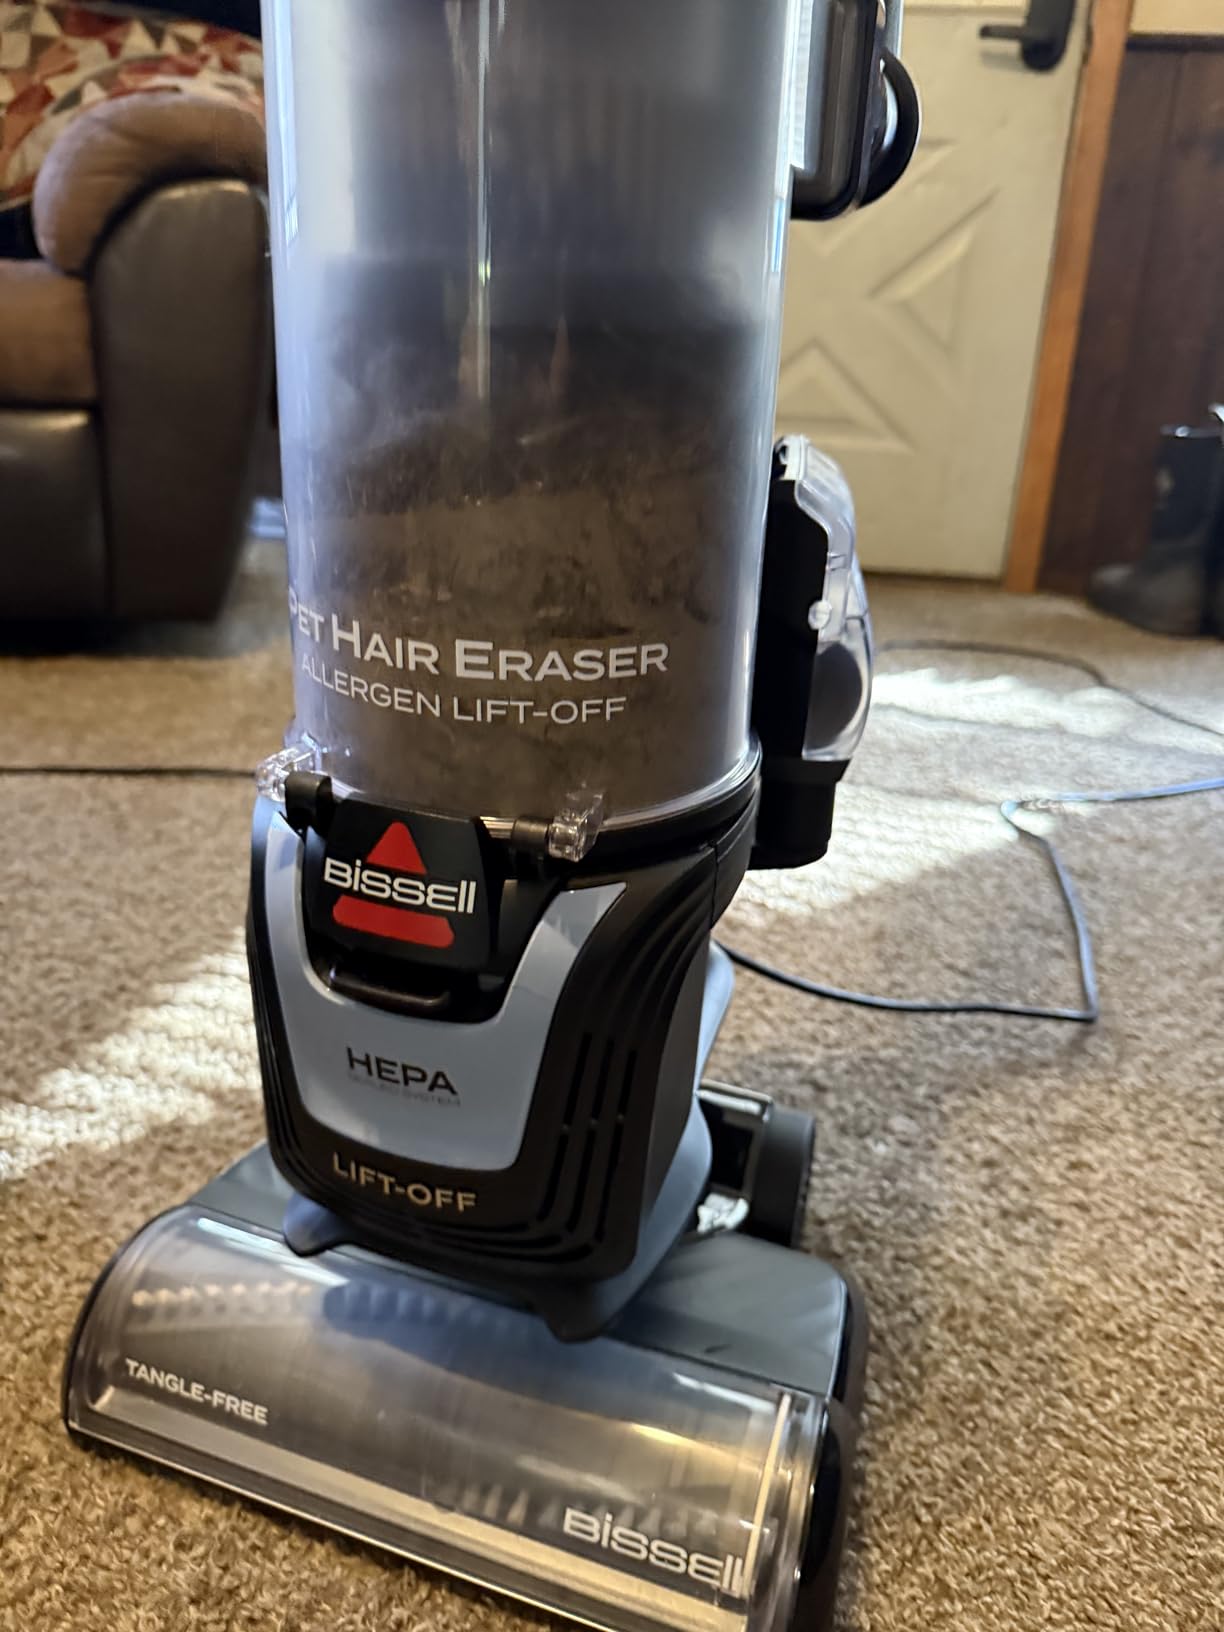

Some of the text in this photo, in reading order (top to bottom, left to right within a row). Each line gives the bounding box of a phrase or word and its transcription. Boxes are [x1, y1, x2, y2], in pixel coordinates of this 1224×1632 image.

[331, 613, 440, 676] HAIR
[454, 638, 669, 682] ERASER
[301, 653, 627, 724] ALLERGEN LIFT-OFF
[346, 1047, 458, 1096] HEPA
[333, 1151, 476, 1212] LIFT-OFF
[125, 1357, 268, 1425] TANGLE-FREE
